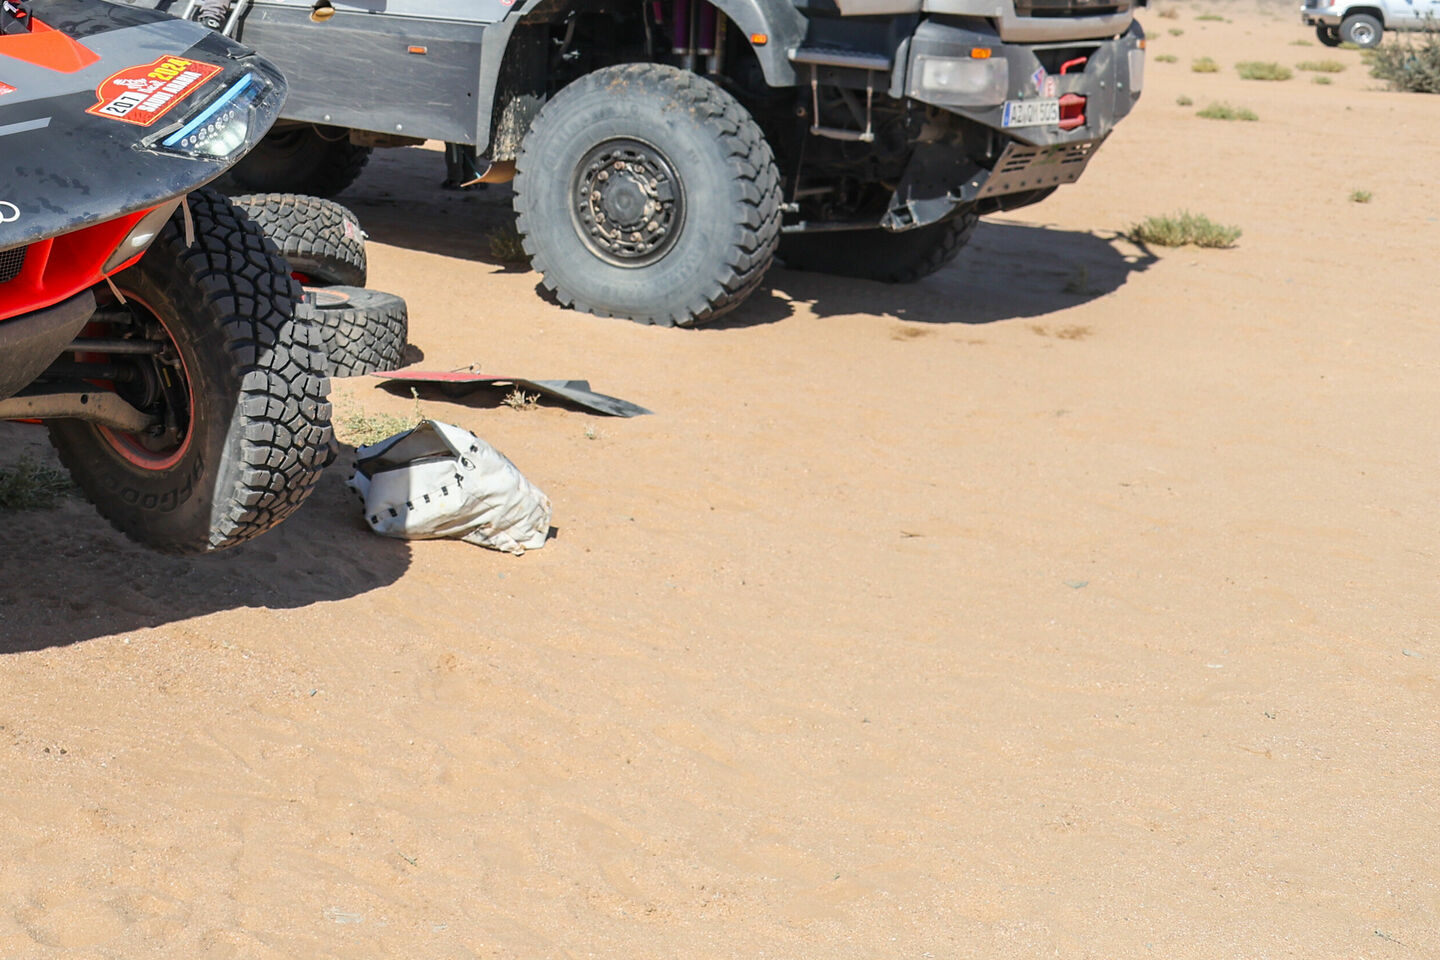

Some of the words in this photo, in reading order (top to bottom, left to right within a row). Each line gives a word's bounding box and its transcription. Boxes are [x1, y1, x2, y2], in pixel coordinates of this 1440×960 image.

[147, 58, 192, 81] 2024
[137, 92, 174, 112] SAUDI
[162, 71, 202, 94] ARABIA
[106, 96, 140, 114] 207
